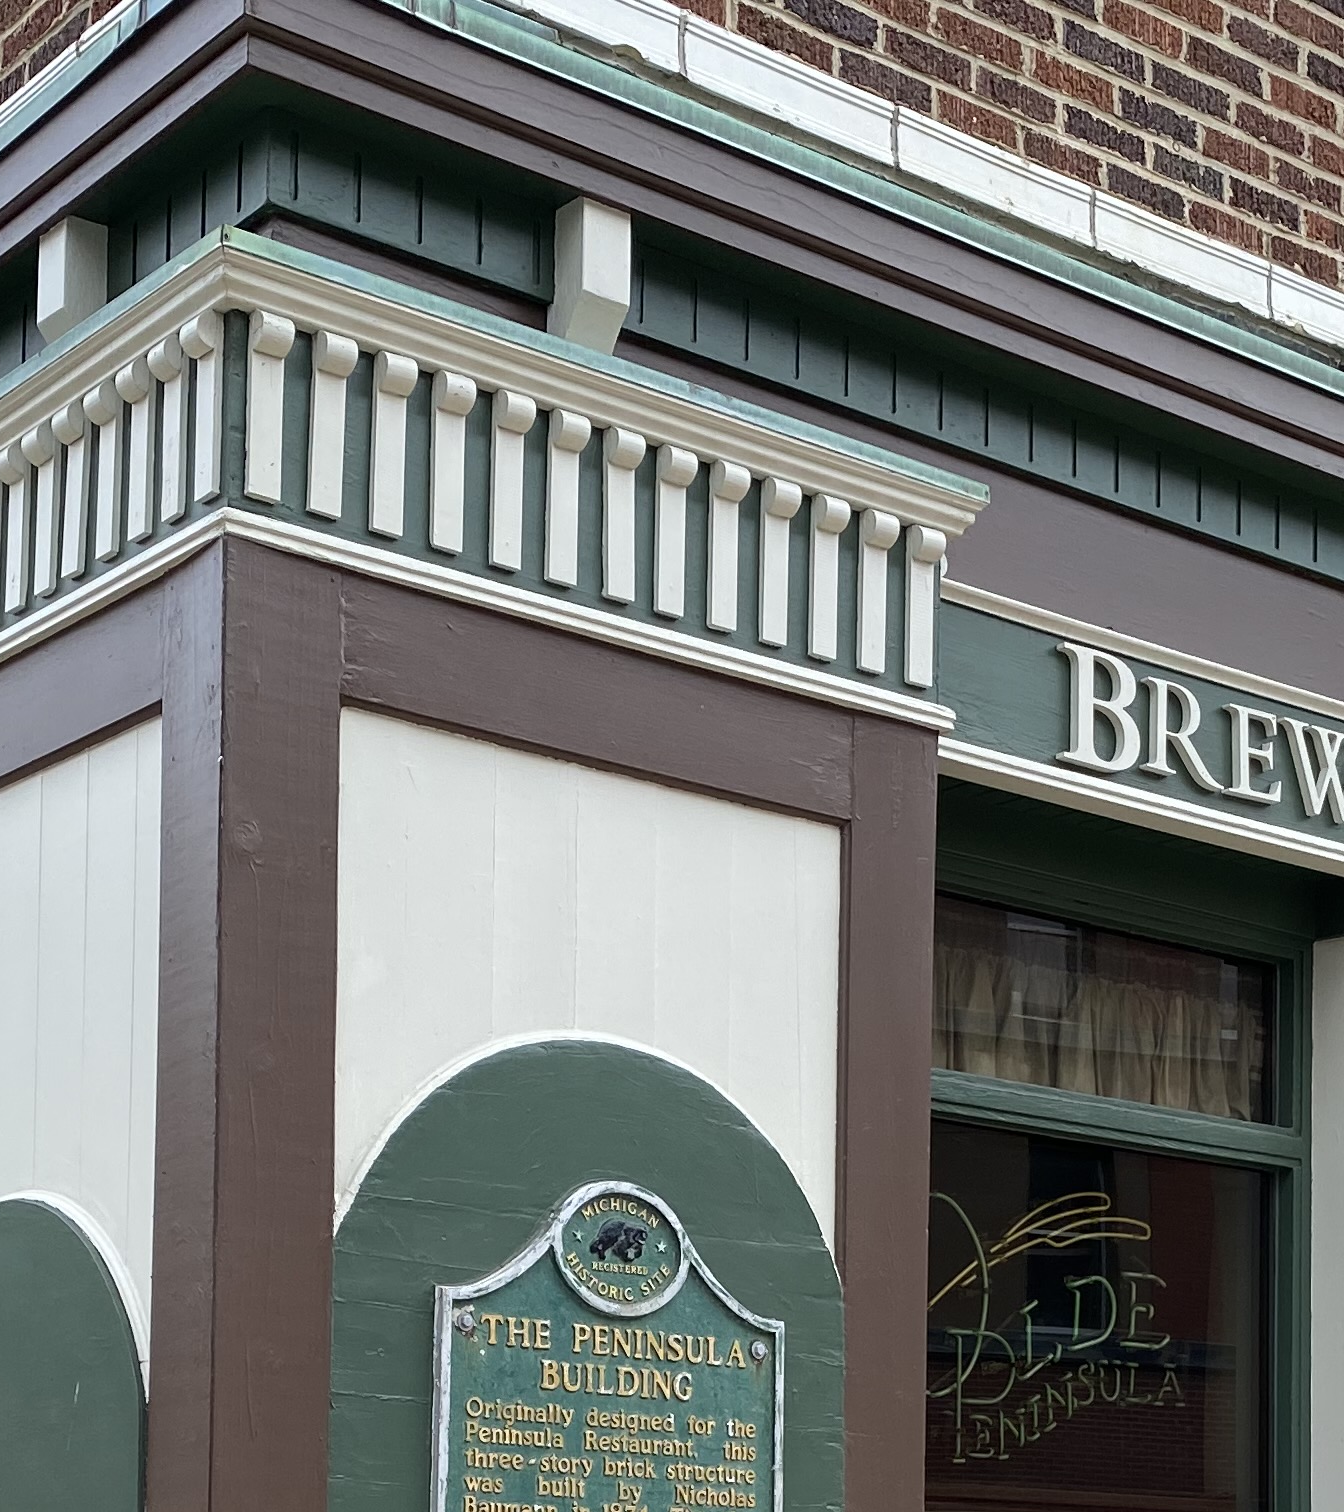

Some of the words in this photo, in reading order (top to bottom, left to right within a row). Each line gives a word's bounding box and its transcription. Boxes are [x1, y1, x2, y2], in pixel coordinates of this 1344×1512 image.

[581, 1198, 659, 1229] MICHIGAN
[565, 1251, 635, 1301] HISTORIC
[640, 1262, 671, 1297] SITE
[591, 1261, 649, 1276] REGISTERED
[480, 1314, 552, 1350] THE
[573, 1324, 747, 1369] PENINSULA
[540, 1358, 693, 1401] BUILDING
[945, 1328, 1187, 1463] PENINSULA
[465, 1396, 575, 1428] Originally
[586, 1407, 675, 1434] designed
[687, 1414, 715, 1435] for
[726, 1419, 756, 1438] the
[465, 1420, 564, 1448] Peninsula
[584, 1430, 698, 1459] Restaurant,
[723, 1440, 756, 1462] this
[603, 1456, 656, 1479] brick
[666, 1461, 756, 1484] structure
[464, 1476, 504, 1493] was
[536, 1475, 585, 1498] built
[618, 1480, 642, 1504] by
[675, 1484, 756, 1508] Nicholas
